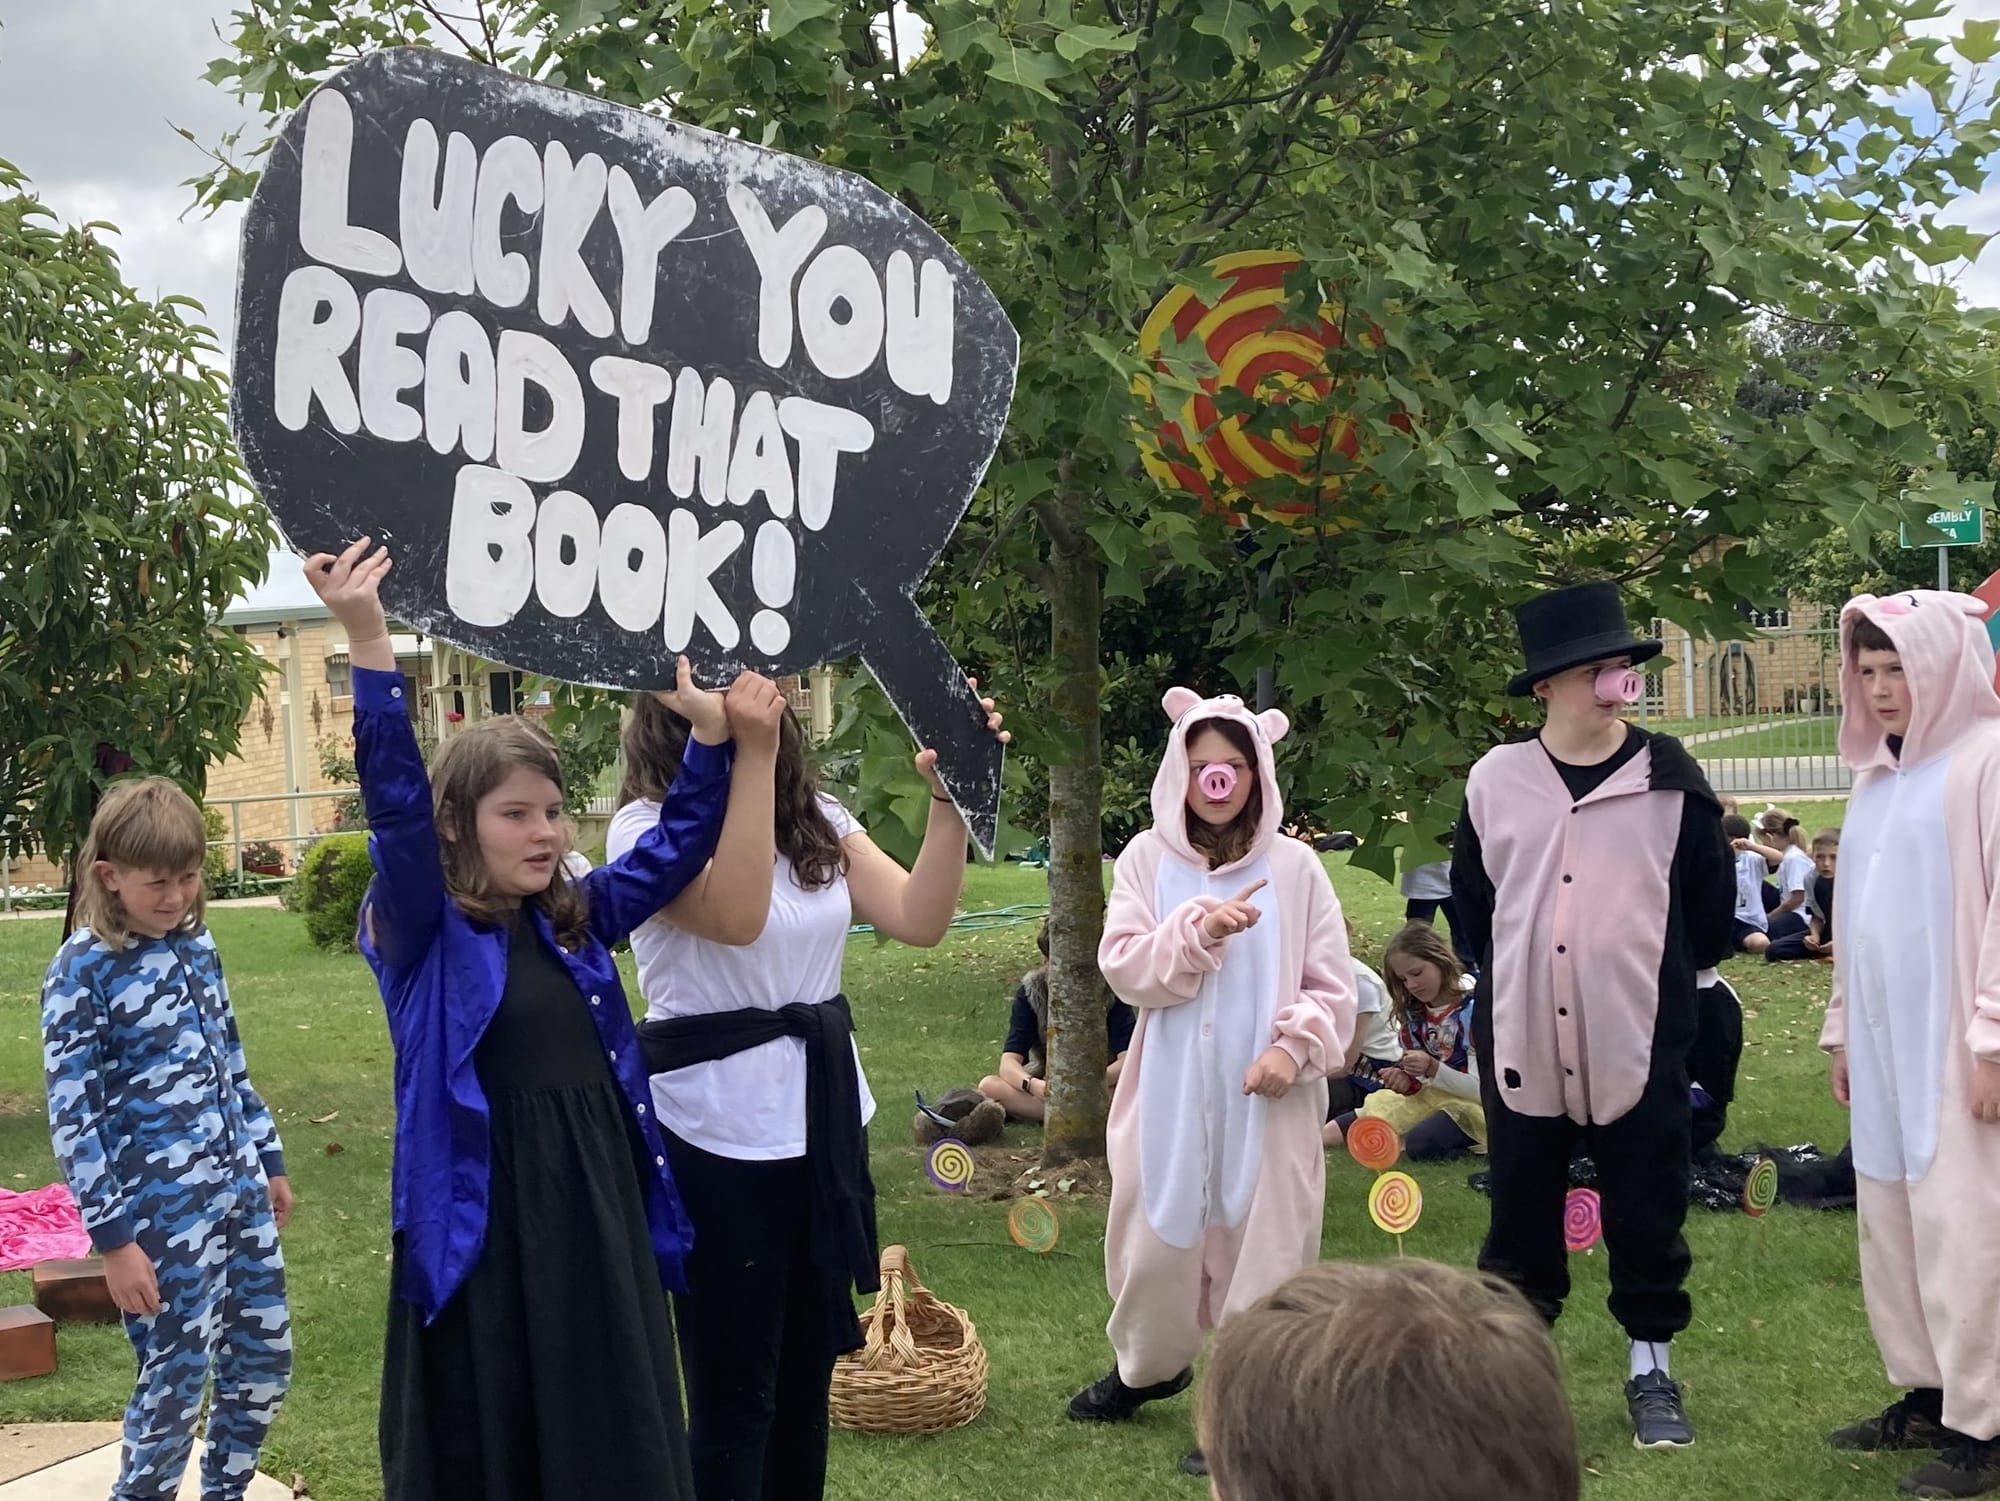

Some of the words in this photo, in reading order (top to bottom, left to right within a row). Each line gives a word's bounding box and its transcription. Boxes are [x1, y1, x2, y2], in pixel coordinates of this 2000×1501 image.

[299, 88, 697, 345] LUCKY
[726, 182, 955, 405] YOU
[273, 264, 586, 483] READ
[590, 354, 875, 532] THAT
[446, 464, 797, 655] BOOK!
[1926, 510, 1973, 524] SEMBLY
